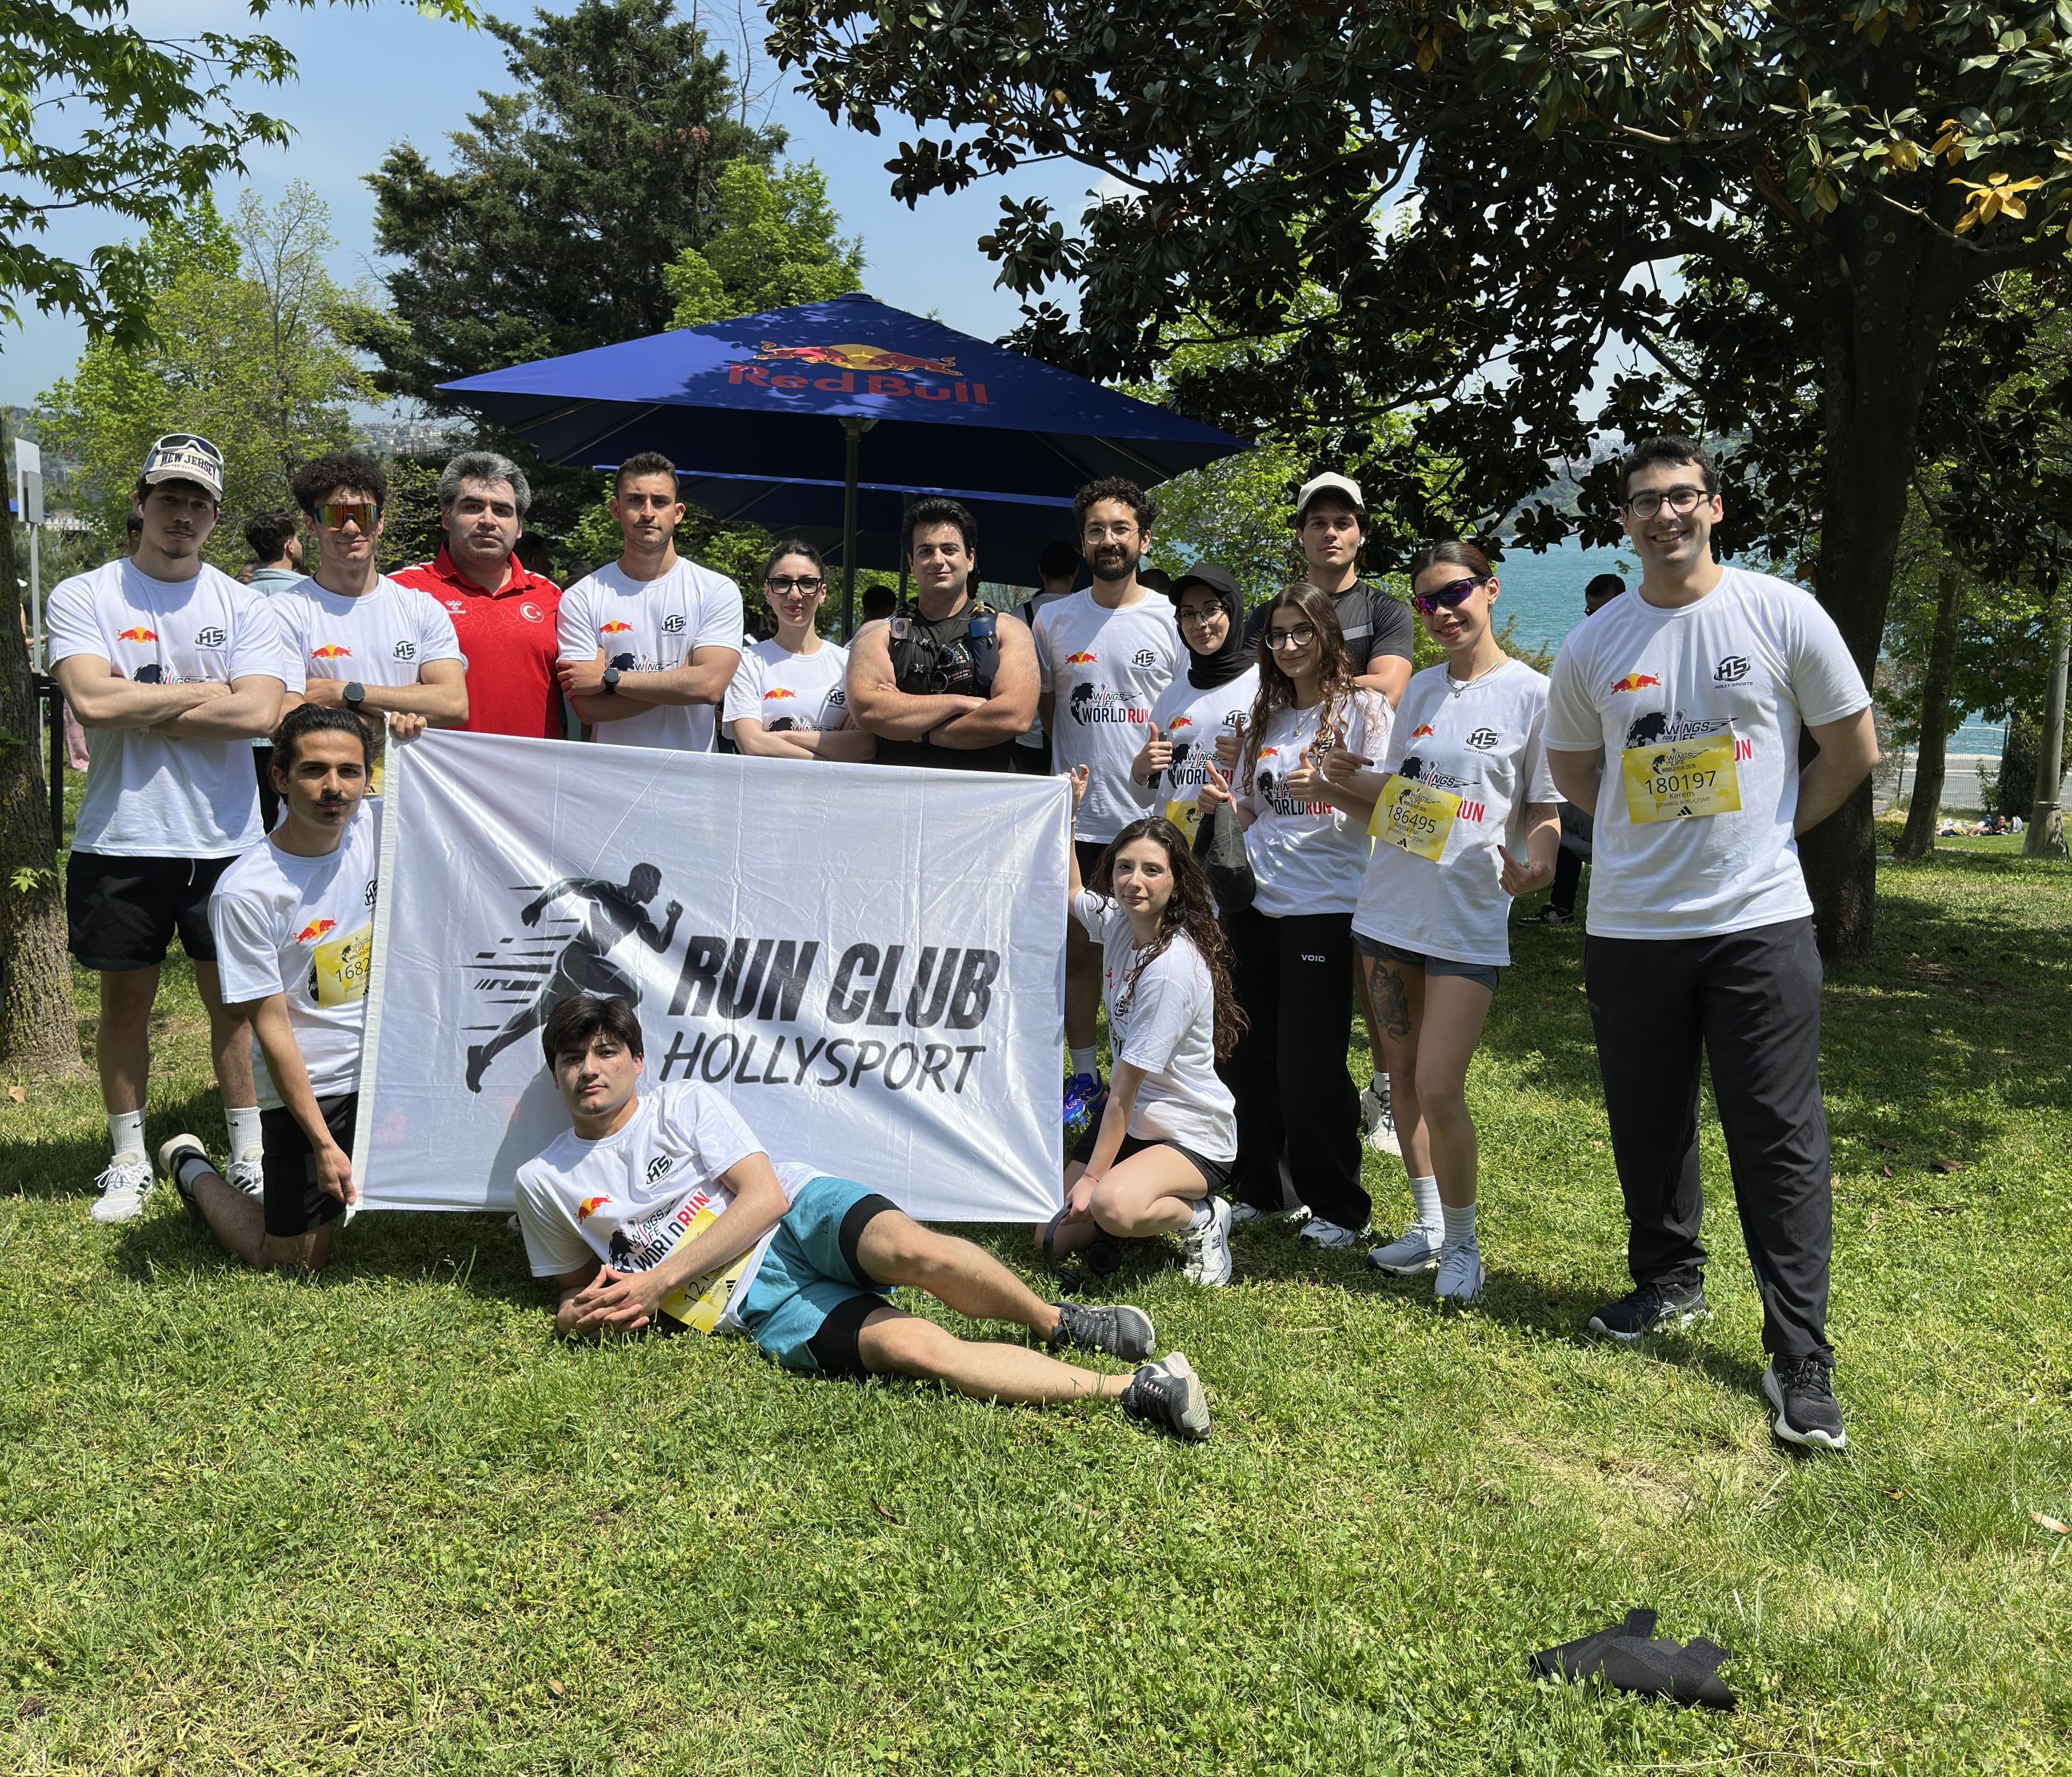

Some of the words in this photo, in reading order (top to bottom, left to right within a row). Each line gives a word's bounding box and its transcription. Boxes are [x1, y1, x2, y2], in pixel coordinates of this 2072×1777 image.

[727, 364, 855, 393] Red
[867, 374, 988, 405] Bull
[160, 451, 184, 467] NEW
[184, 454, 216, 481] JERSEY
[635, 662, 662, 671] WING
[1093, 692, 1125, 700] WINGS
[1082, 707, 1126, 723] WORLD
[1128, 708, 1149, 724] RUN
[1666, 721, 1710, 736] WINGS
[1187, 752, 1217, 761] WINGS
[1666, 752, 1693, 761] WINGS
[1735, 738, 1752, 762] UN
[1177, 768, 1219, 785] WORL
[1420, 771, 1456, 786] WINGS
[1645, 770, 1716, 795] 180197
[1410, 792, 1429, 802] WINGS
[1669, 791, 1694, 799] Kerem
[1274, 799, 1305, 815] ORLD
[1388, 804, 1437, 834] 186495
[1301, 954, 1326, 962] VOID
[335, 957, 371, 983] 1682
[666, 935, 820, 1022] RUN
[825, 943, 1001, 1030] CLUB
[658, 1031, 986, 1095] HOLLYSPORT
[649, 1179, 662, 1191] HOLLY
[662, 1169, 678, 1182] SPORTS
[628, 1209, 664, 1246] WINGS
[640, 1224, 661, 1248] LIFE
